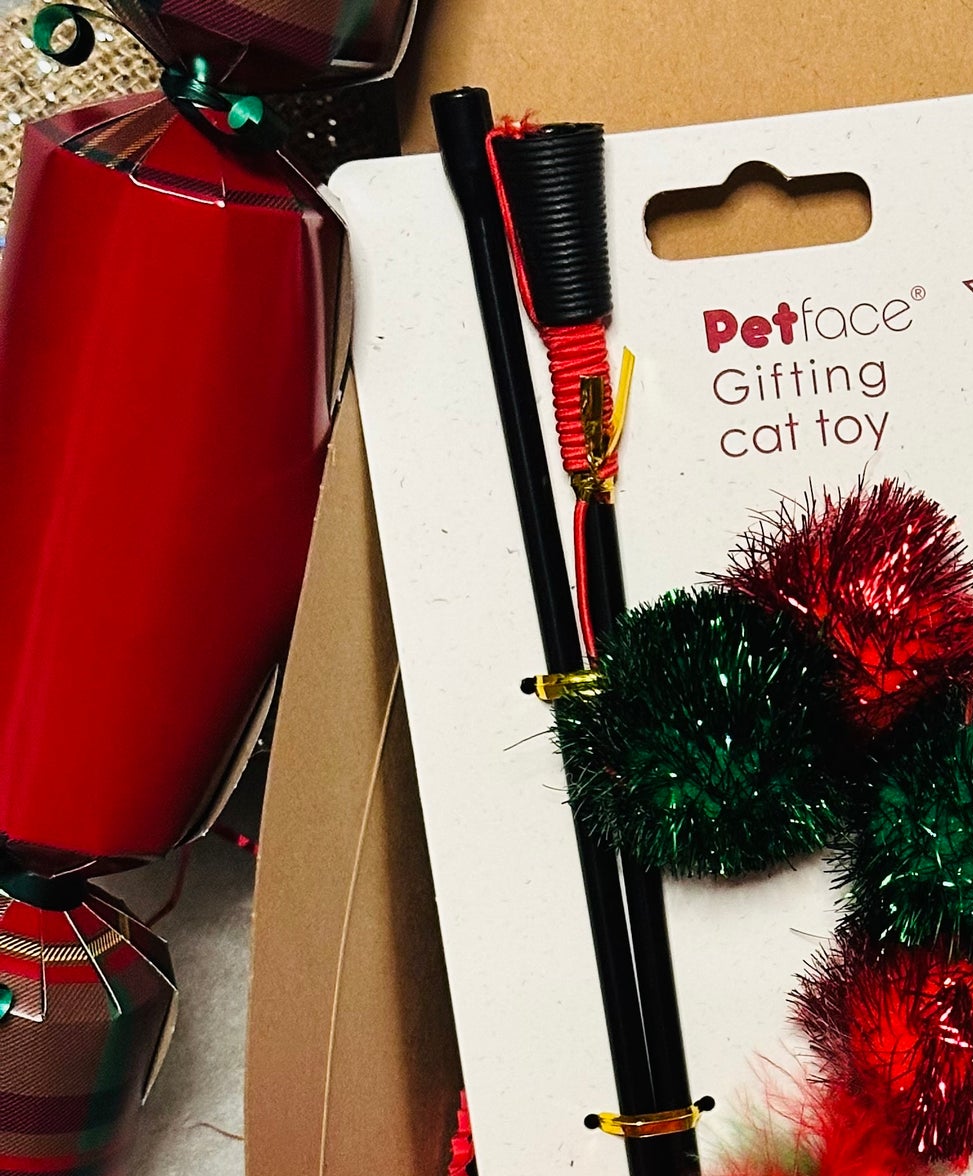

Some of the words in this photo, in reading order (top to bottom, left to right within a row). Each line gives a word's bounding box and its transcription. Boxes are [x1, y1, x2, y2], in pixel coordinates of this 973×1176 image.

[713, 358, 886, 405] Gifting
[720, 412, 799, 458] cat
[815, 409, 889, 451] toy
